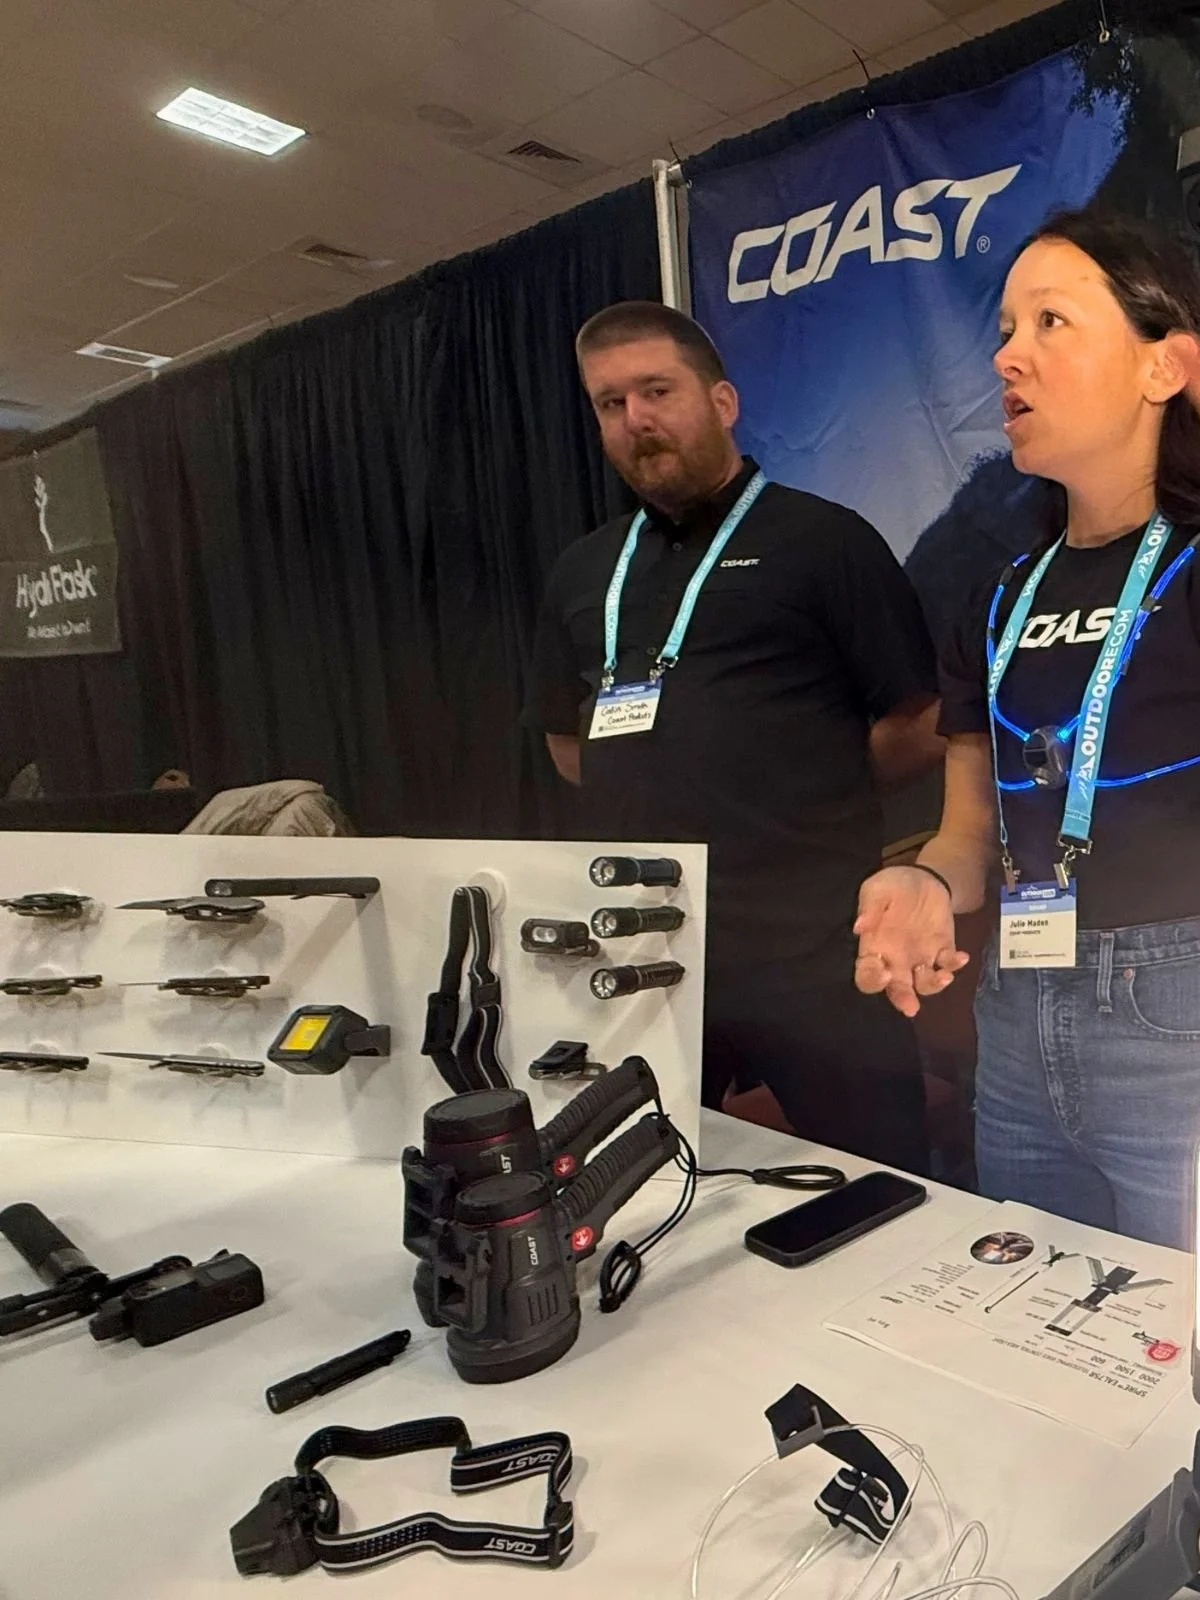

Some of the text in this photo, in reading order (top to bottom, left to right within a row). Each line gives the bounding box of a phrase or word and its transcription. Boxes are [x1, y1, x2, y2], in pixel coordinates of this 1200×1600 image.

[728, 164, 1022, 303] COAST
[720, 558, 760, 567] COAST
[1018, 605, 1162, 648] OAS
[530, 1236, 539, 1266] COAST
[484, 1537, 537, 1554] COAST
